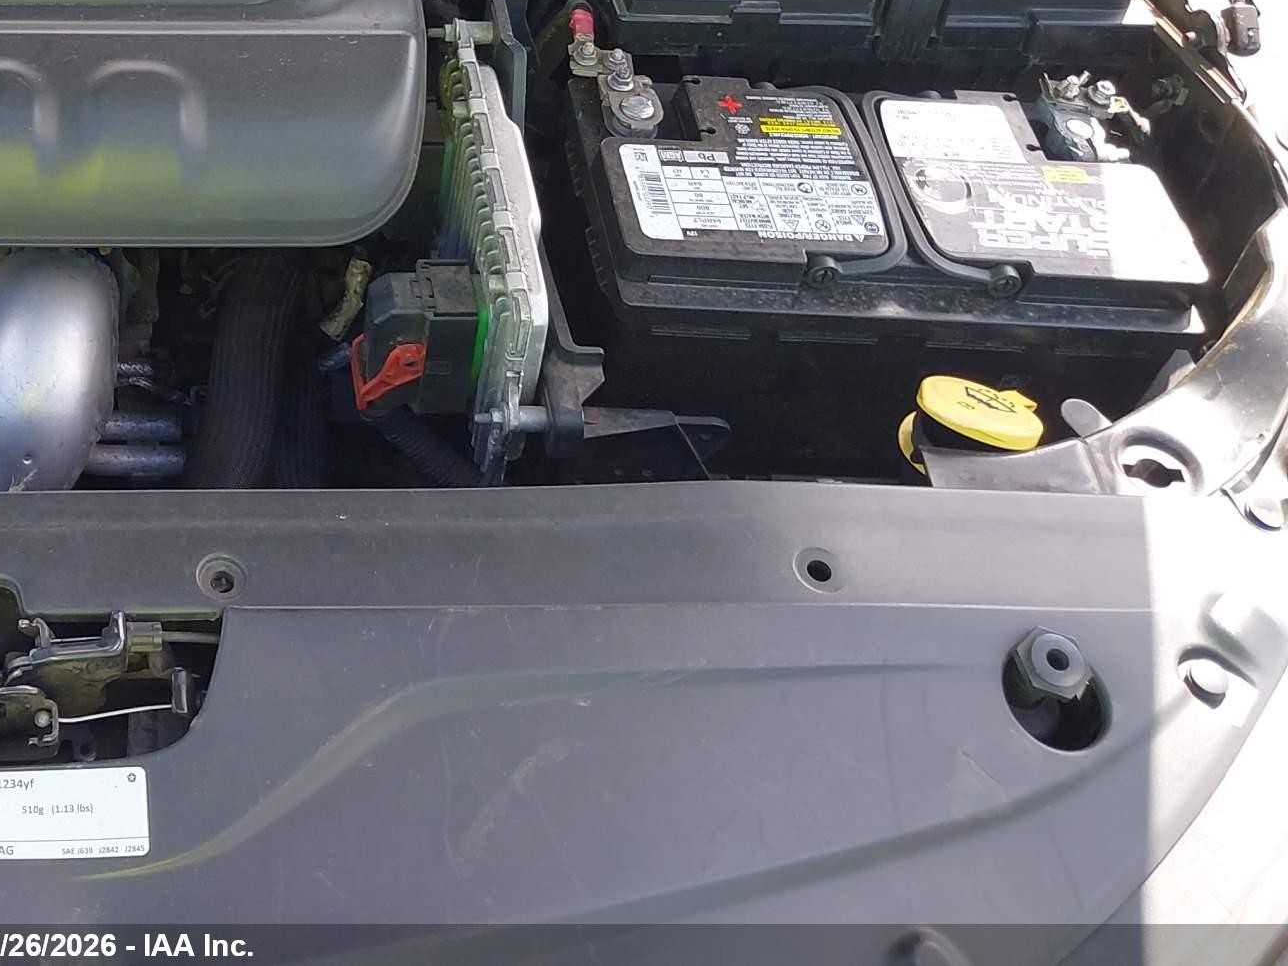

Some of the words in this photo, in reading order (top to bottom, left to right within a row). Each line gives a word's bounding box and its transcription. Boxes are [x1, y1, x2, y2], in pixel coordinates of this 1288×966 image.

[757, 231, 854, 242] DANGER/POISON
[21, 805, 44, 816] 510g
[51, 805, 75, 816] (1.13
[77, 803, 94, 815] lbs)
